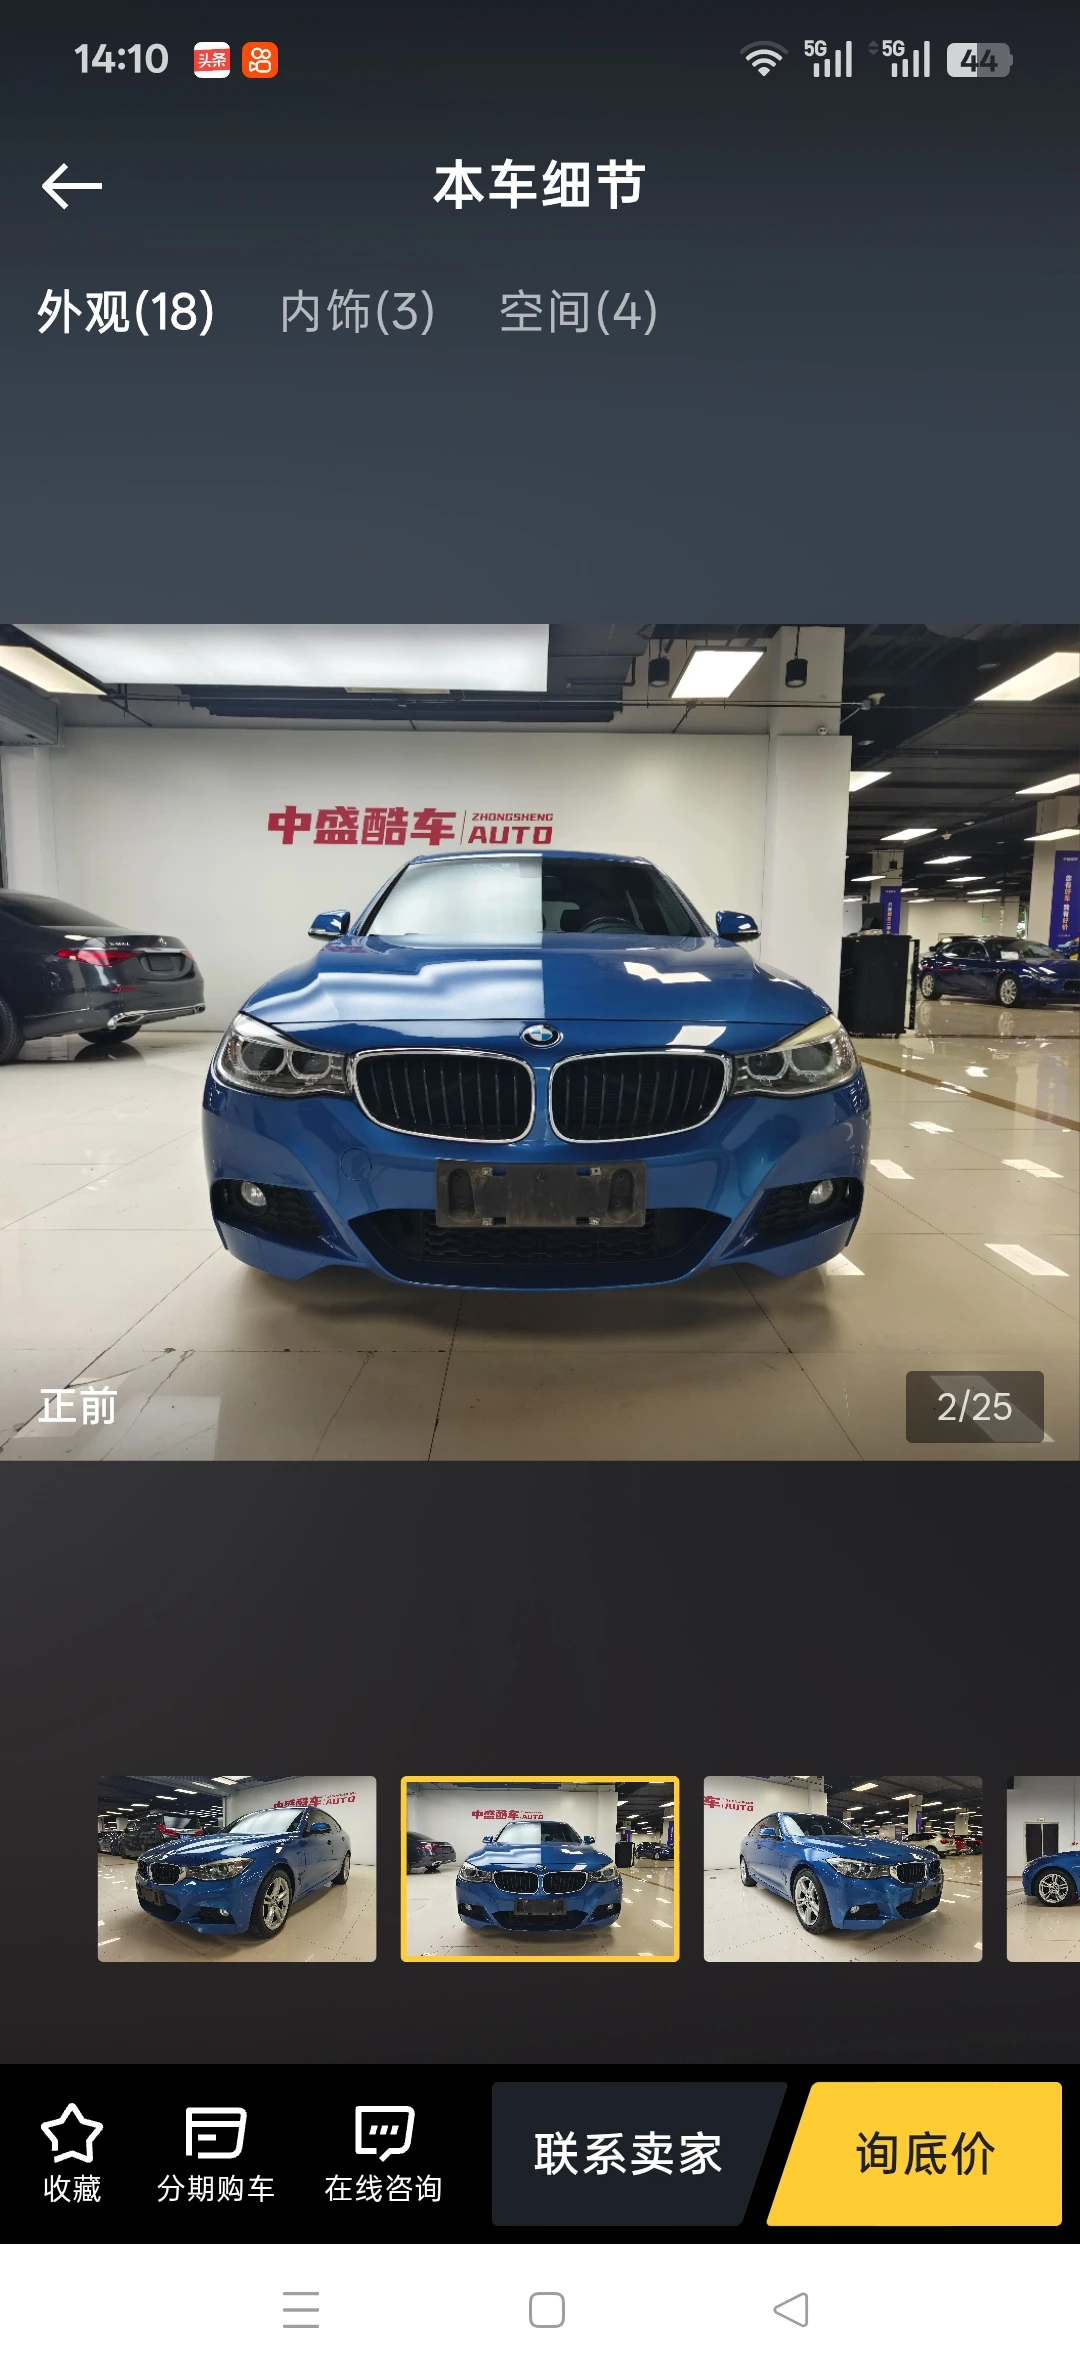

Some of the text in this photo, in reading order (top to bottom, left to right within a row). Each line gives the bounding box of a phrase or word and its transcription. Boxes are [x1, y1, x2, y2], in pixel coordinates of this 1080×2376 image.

[75, 44, 168, 73] 14:10
[197, 52, 227, 69] 头条
[804, 39, 828, 57] 5G
[882, 39, 906, 57] 5G
[960, 49, 998, 72] 44
[433, 158, 646, 210] 本车细节
[36, 288, 214, 337] 外观(18)
[281, 288, 434, 337] 内饰(3)
[499, 288, 658, 337] 空间(4)
[267, 805, 457, 846] 中盛酷车
[471, 812, 554, 822] ZHONGSHENG
[467, 826, 553, 845] AUTO
[38, 1385, 118, 1425] 正前
[938, 1389, 1012, 1423] 2/25
[534, 2130, 723, 2176] 联系卖家
[855, 2130, 996, 2176] 询底价
[43, 2174, 102, 2204] 收藏
[157, 2174, 275, 2203] 分期购车
[324, 2174, 442, 2203] 在线咨询
